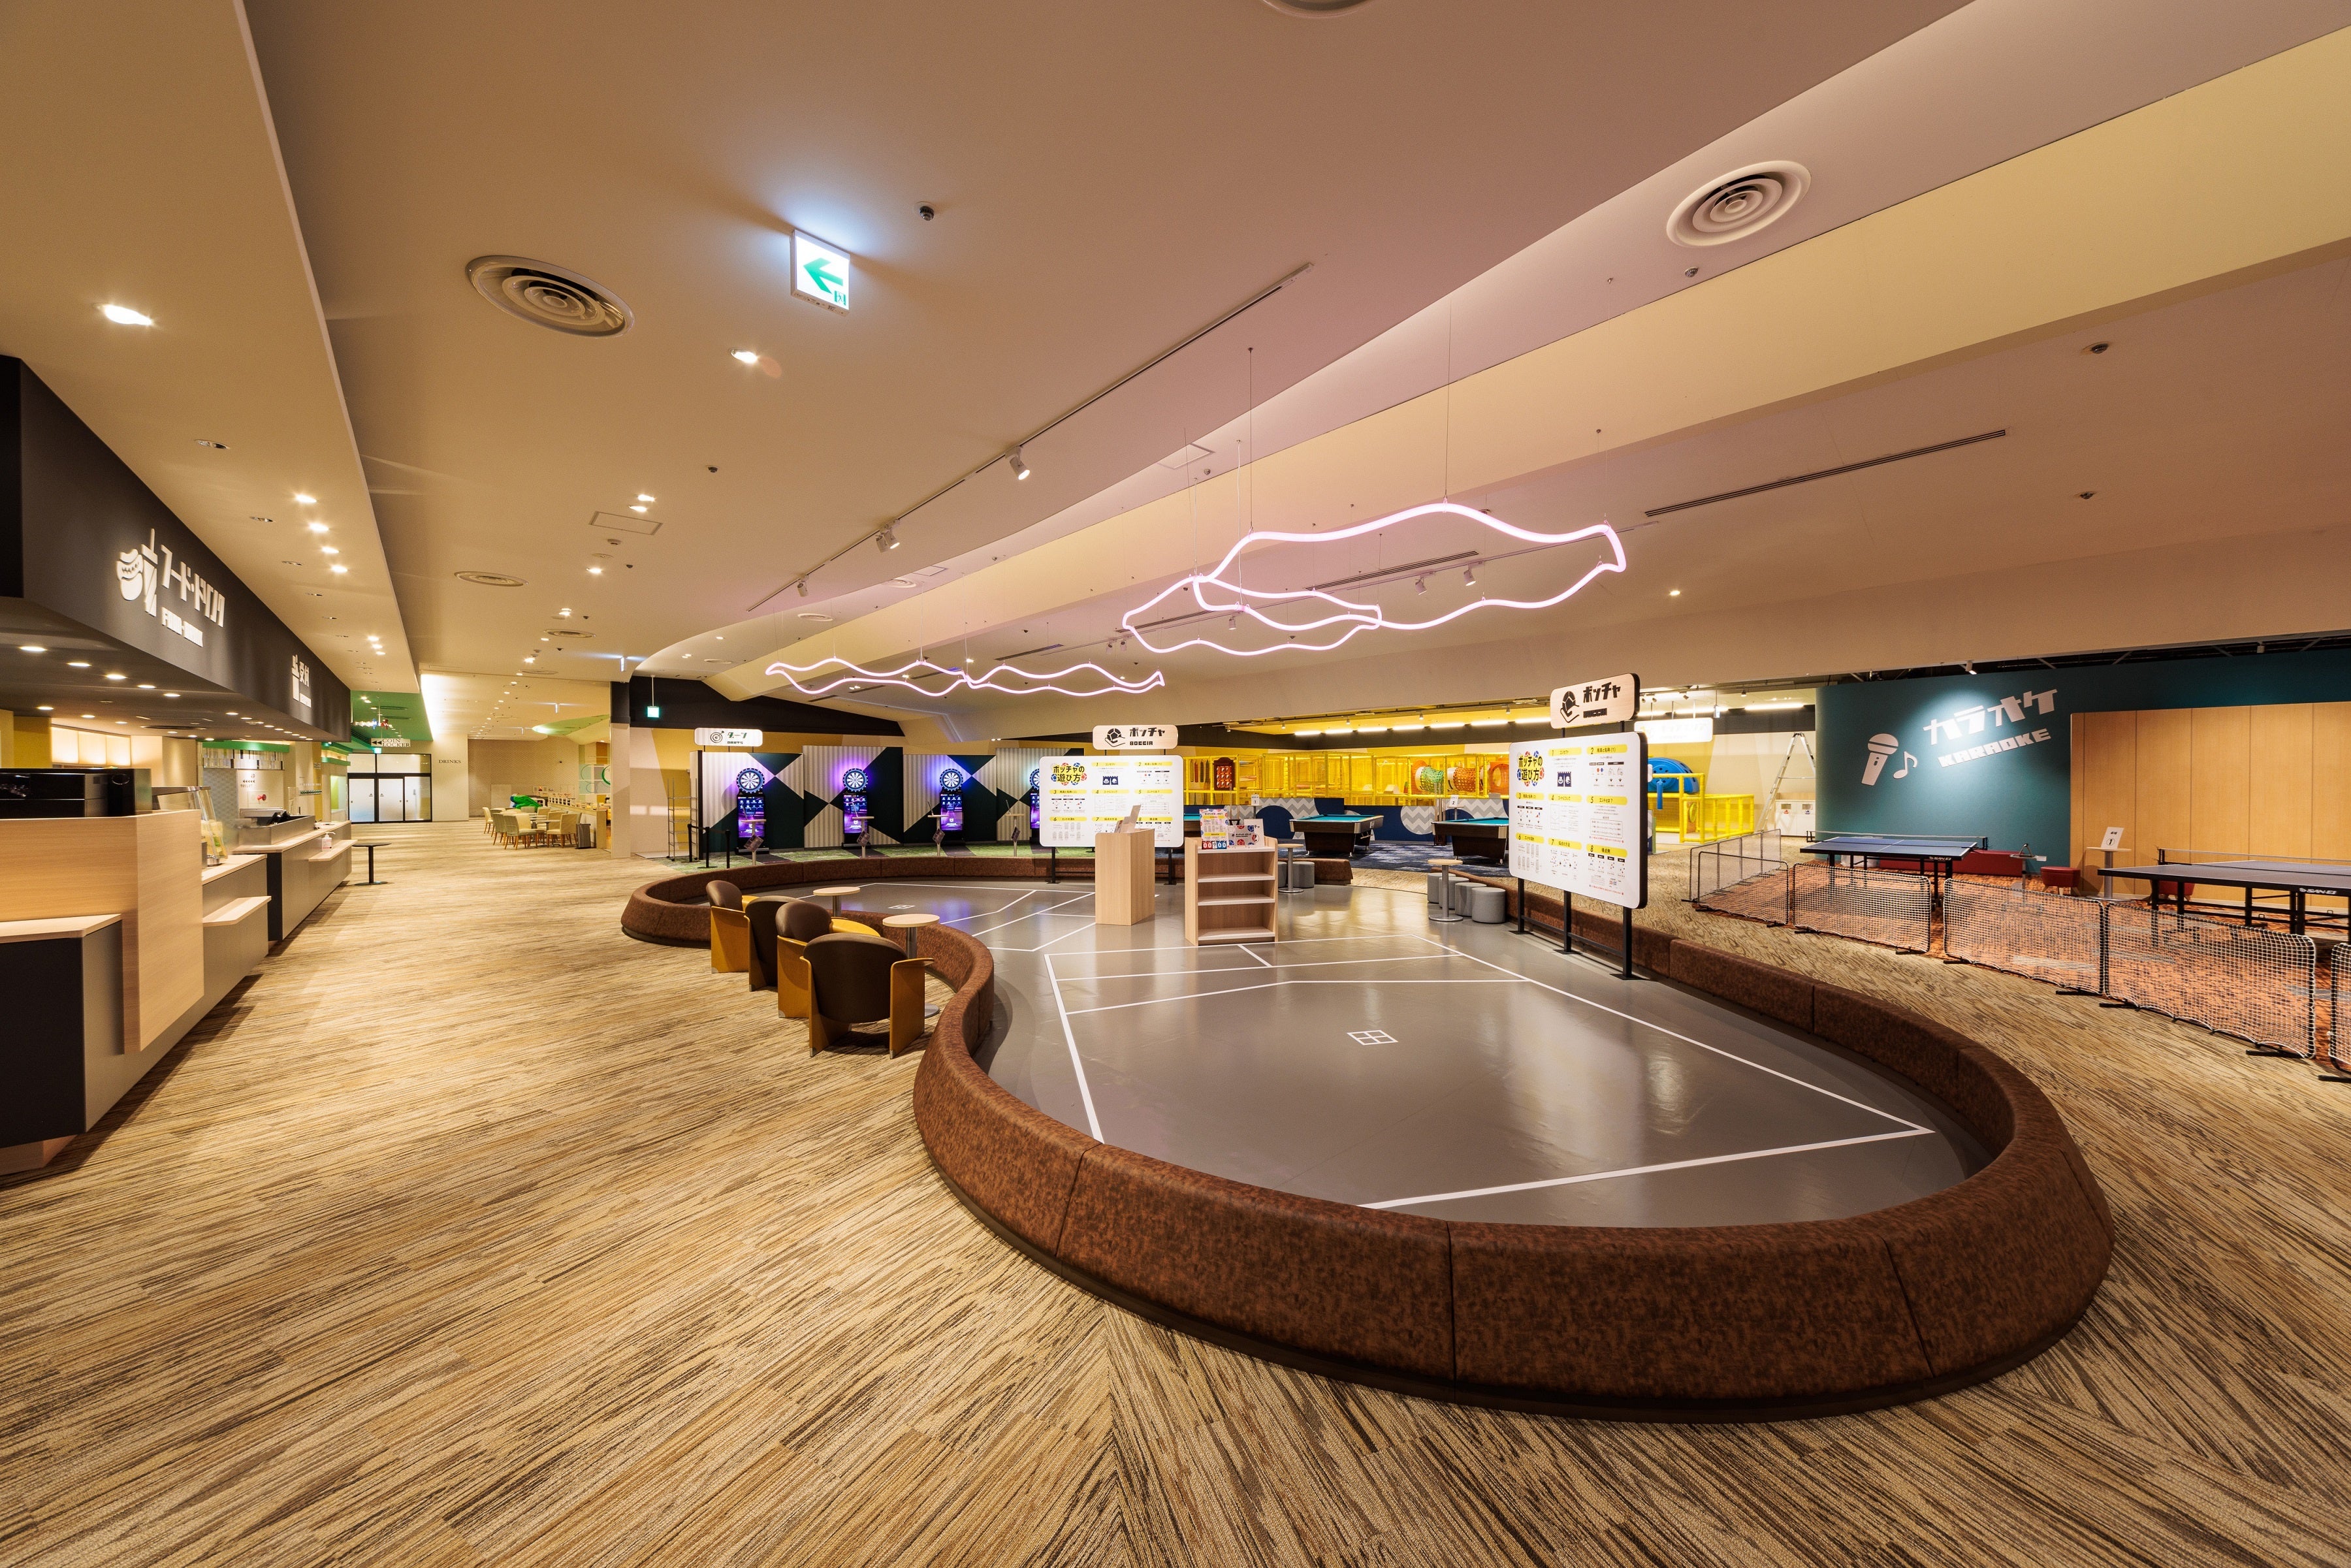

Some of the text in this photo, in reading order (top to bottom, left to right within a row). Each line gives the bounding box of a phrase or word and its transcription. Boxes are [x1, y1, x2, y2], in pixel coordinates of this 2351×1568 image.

[1583, 682, 1621, 703] ボッチャ
[1923, 688, 2058, 745] カラオケ
[1130, 727, 1165, 737] ボッチャ
[1937, 728, 2051, 768] KARAOKE
[1518, 755, 1543, 767] ボッチャの
[1053, 765, 1085, 773] ボッチャの
[1521, 768, 1540, 781] 遊び方
[1057, 773, 1081, 782] 遊び方
